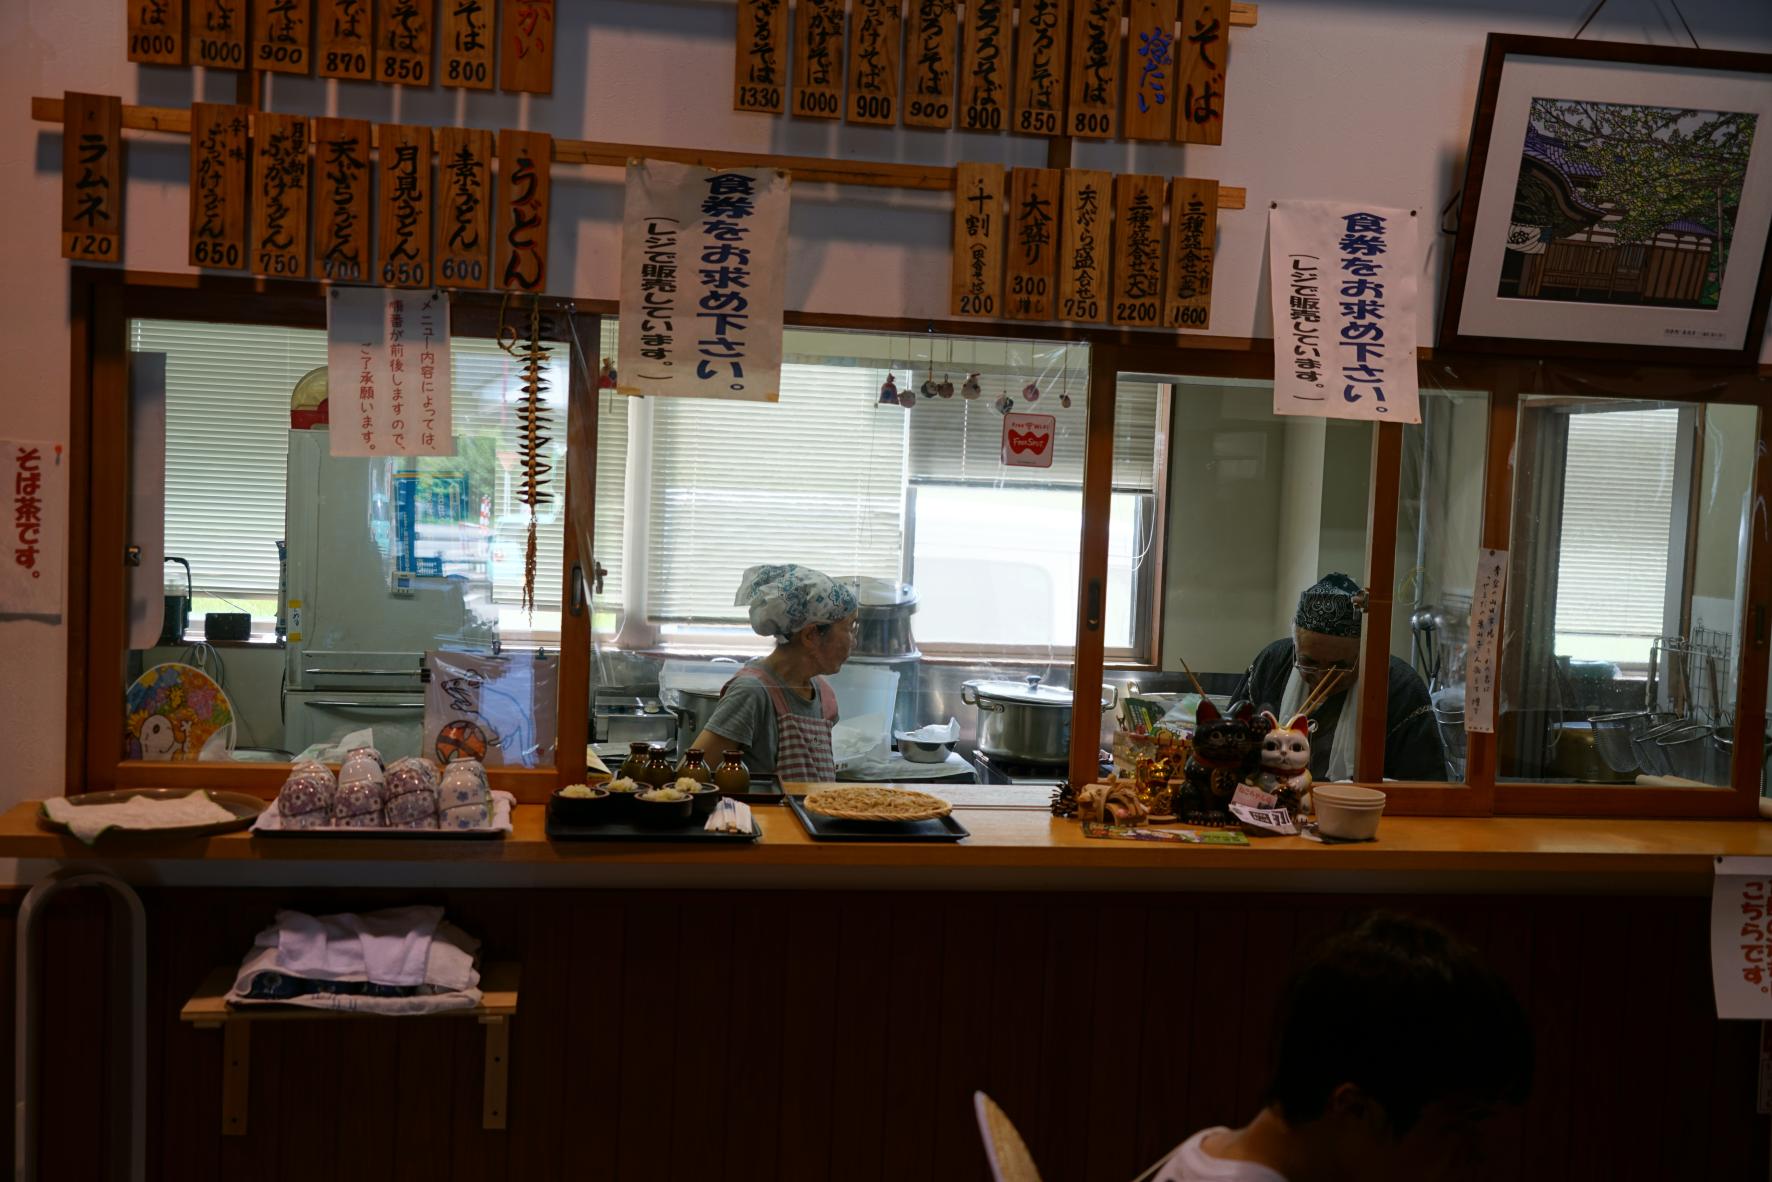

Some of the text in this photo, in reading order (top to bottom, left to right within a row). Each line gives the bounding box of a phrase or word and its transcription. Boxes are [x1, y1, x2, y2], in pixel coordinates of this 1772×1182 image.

[131, 34, 175, 55] 1000
[201, 39, 241, 63] 1000
[259, 44, 302, 64] 900
[326, 52, 366, 73] 870
[384, 56, 423, 81] 850
[448, 59, 487, 82] 800
[1185, 18, 1223, 125] そば
[739, 86, 780, 109] 1330
[800, 90, 838, 113] 1000
[856, 95, 891, 119] 900
[910, 102, 948, 119] 900
[967, 106, 1001, 129] 900
[1021, 110, 1056, 133] 850
[1075, 113, 1109, 133] 800
[74, 134, 110, 227] ラムネ
[388, 144, 423, 261] 月見うどん
[447, 144, 483, 249] 素うどん
[503, 157, 546, 289] うどん
[70, 235, 112, 255] 120
[195, 241, 238, 266] 650
[260, 252, 298, 274] 750
[323, 258, 360, 278] 700
[383, 263, 423, 284] 650
[442, 258, 482, 281] 600
[696, 173, 755, 390] 食券をお求め下さい。
[1013, 276, 1046, 296] 300
[960, 295, 993, 315] 200
[1064, 299, 1097, 319] 750
[1117, 303, 1156, 322] 2200
[1173, 306, 1207, 325] 1600
[1338, 212, 1388, 413] 食券をお求め下さい。
[359, 342, 376, 450] ご了承願います。
[14, 447, 42, 579] そば茶です。
